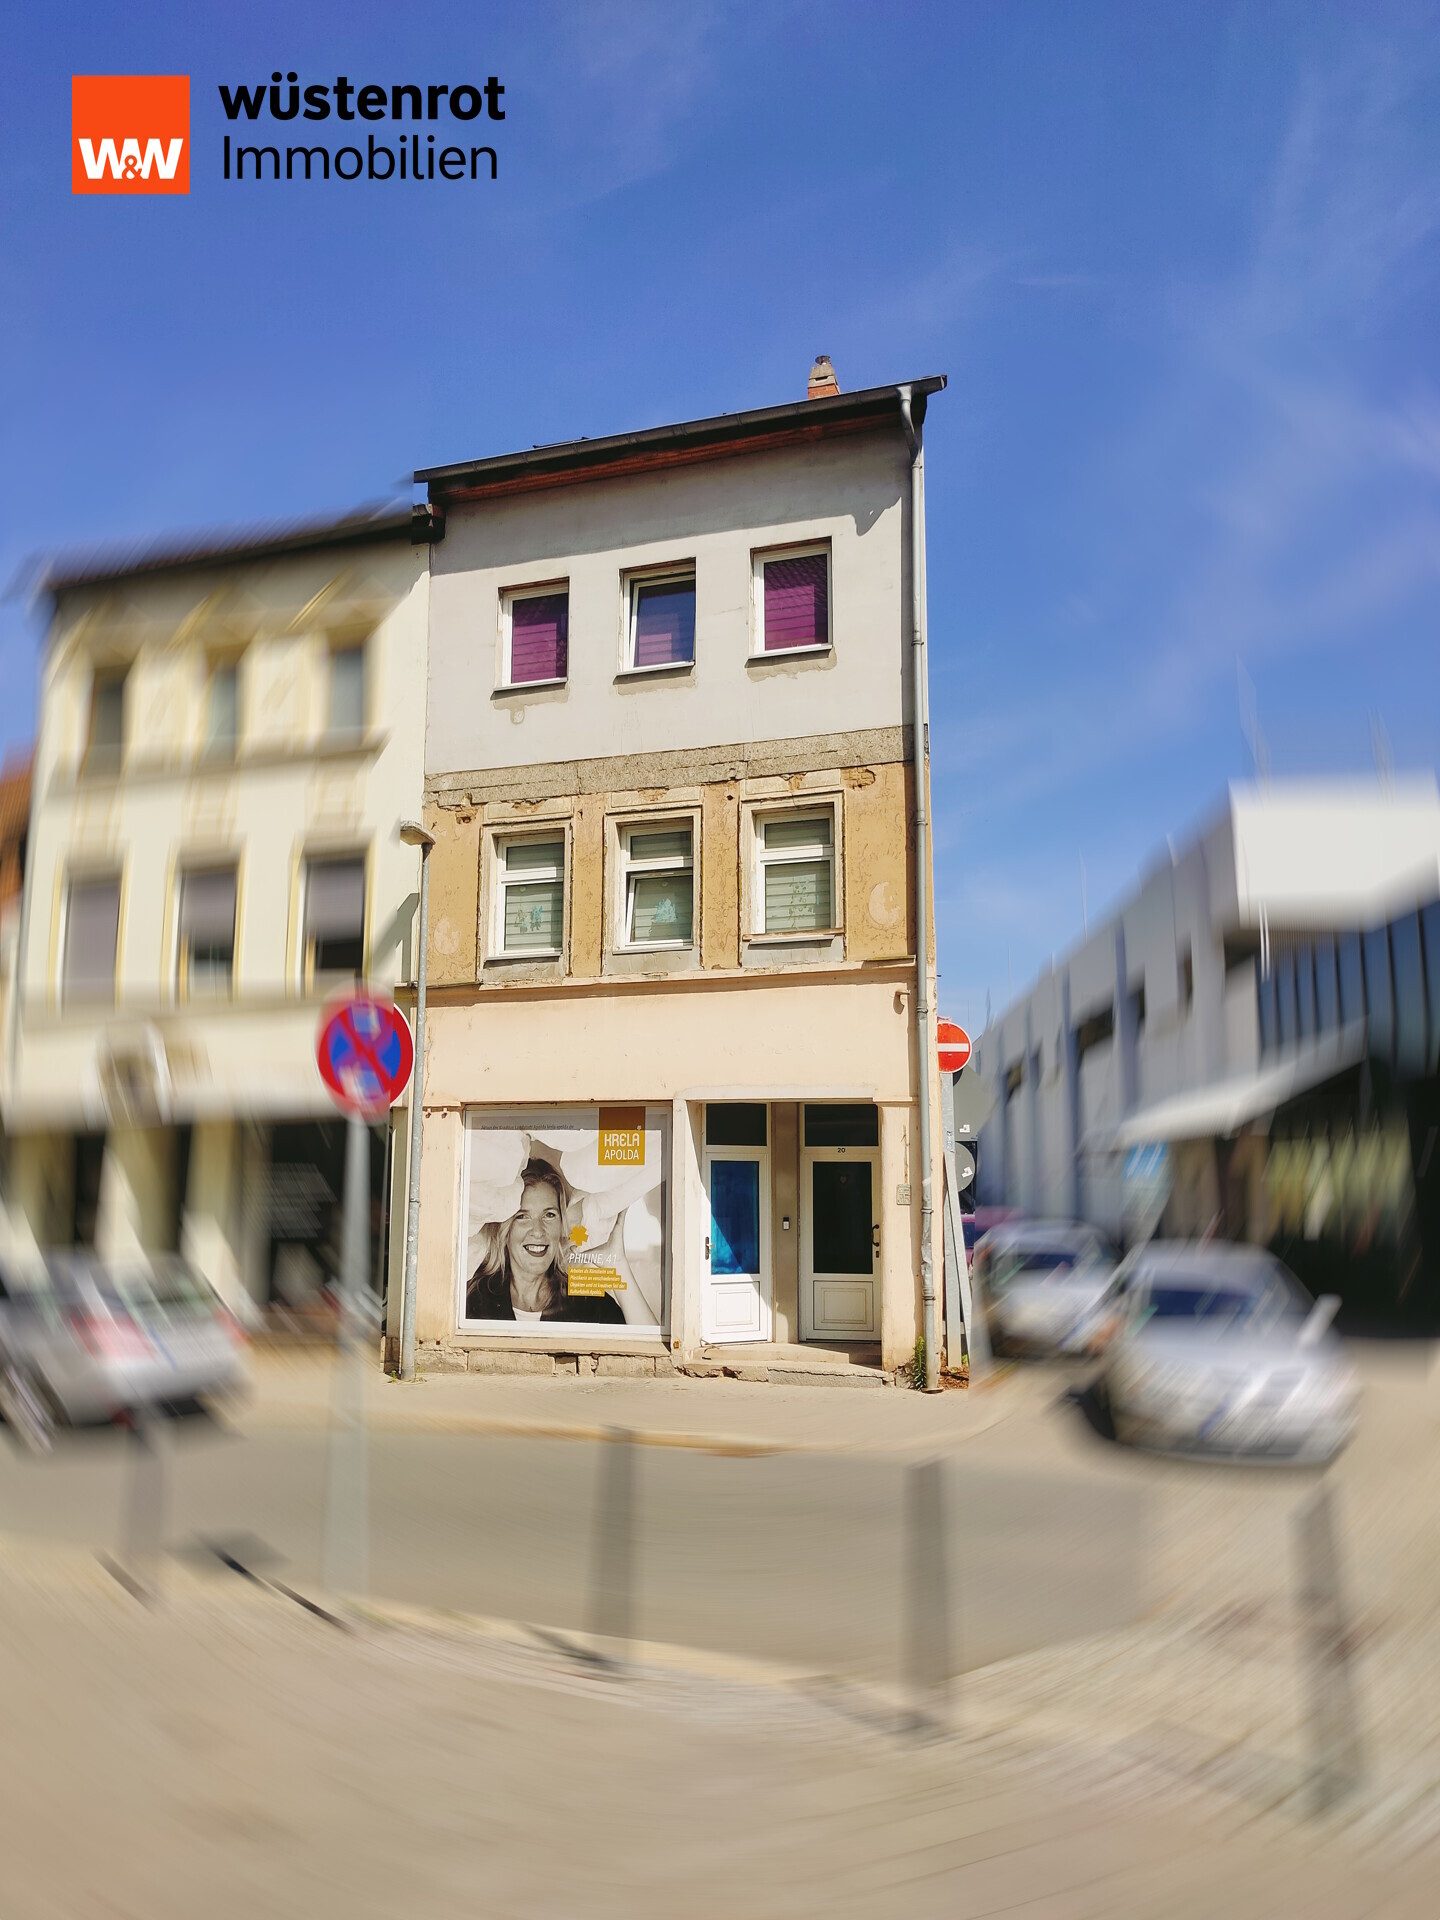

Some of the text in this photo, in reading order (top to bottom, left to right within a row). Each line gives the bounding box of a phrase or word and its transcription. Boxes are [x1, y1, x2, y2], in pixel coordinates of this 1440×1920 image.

[604, 1149, 640, 1160] APOLDA
[568, 1253, 617, 1265] PHILINE, 41
